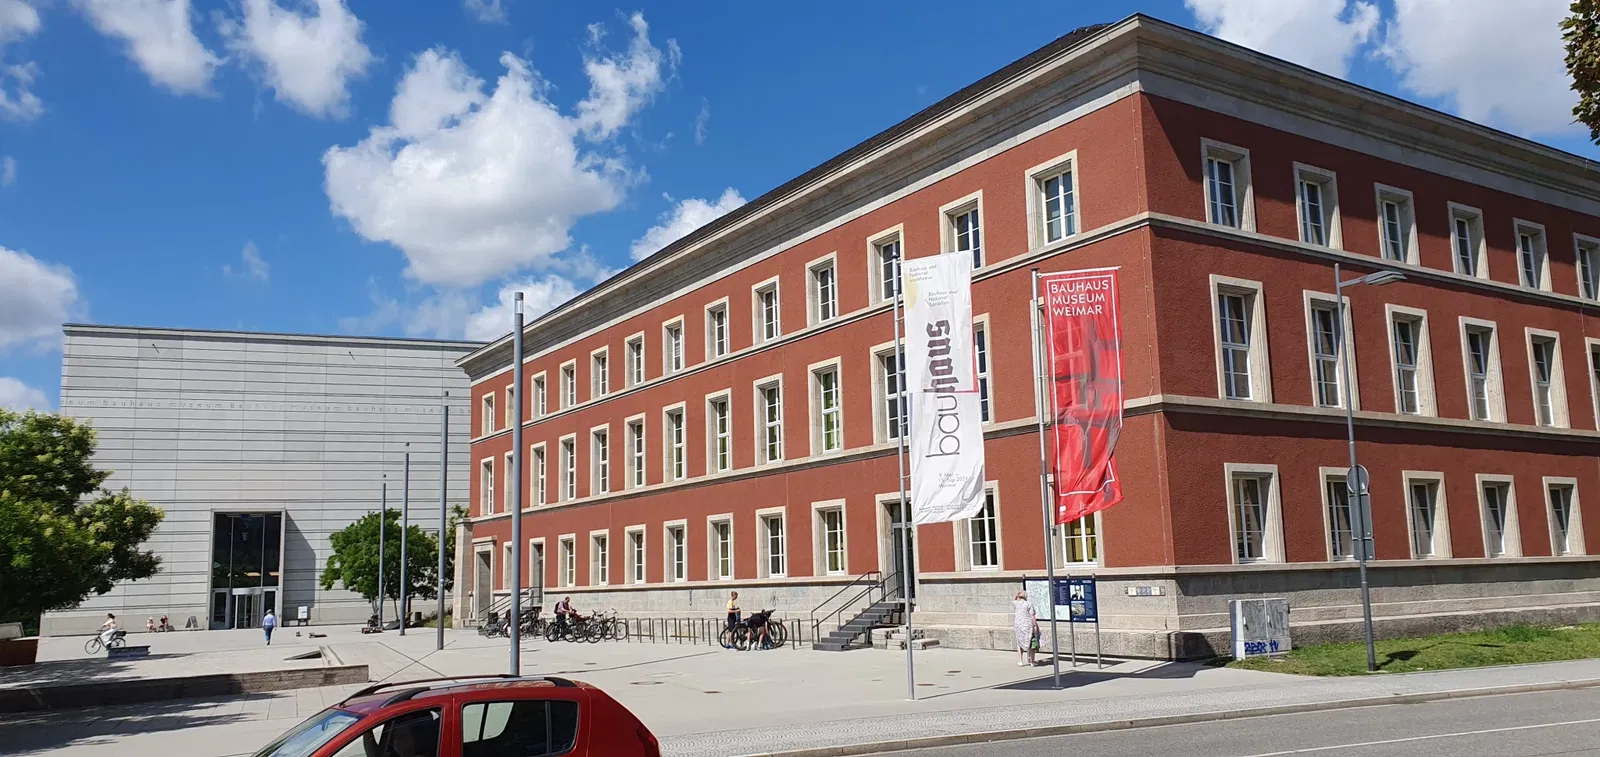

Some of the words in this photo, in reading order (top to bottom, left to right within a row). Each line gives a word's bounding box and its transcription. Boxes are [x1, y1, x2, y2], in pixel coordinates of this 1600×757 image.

[1051, 280, 1109, 293] BAUHAUS
[1052, 293, 1105, 305] MUSEUM
[1053, 304, 1102, 316] WEIMAR
